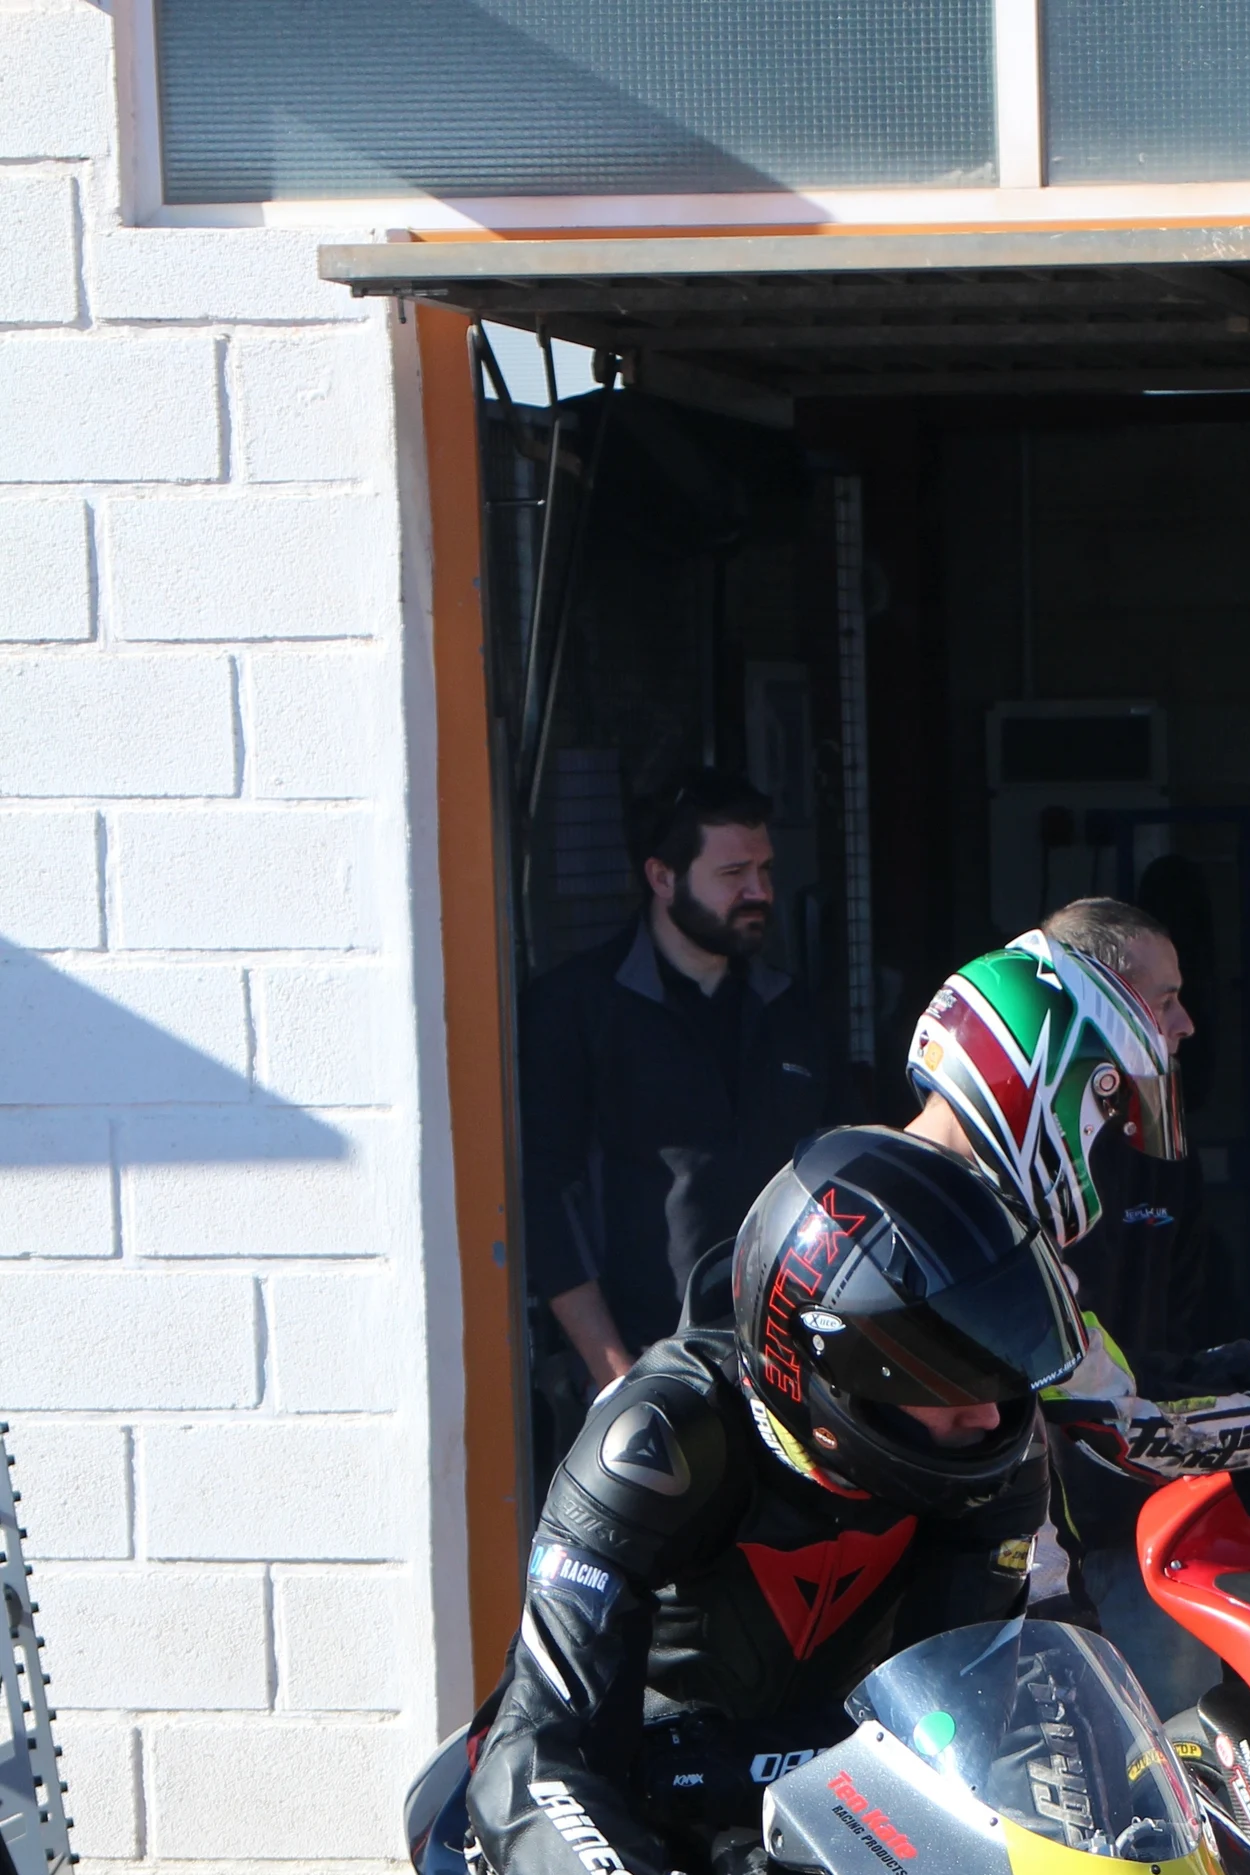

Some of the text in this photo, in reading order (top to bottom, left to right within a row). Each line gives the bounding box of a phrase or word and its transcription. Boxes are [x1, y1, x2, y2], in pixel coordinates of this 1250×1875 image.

[560, 1558, 610, 1593] RACING
[827, 1769, 918, 1860] Ten Kate
[831, 1804, 865, 1836] RACING
